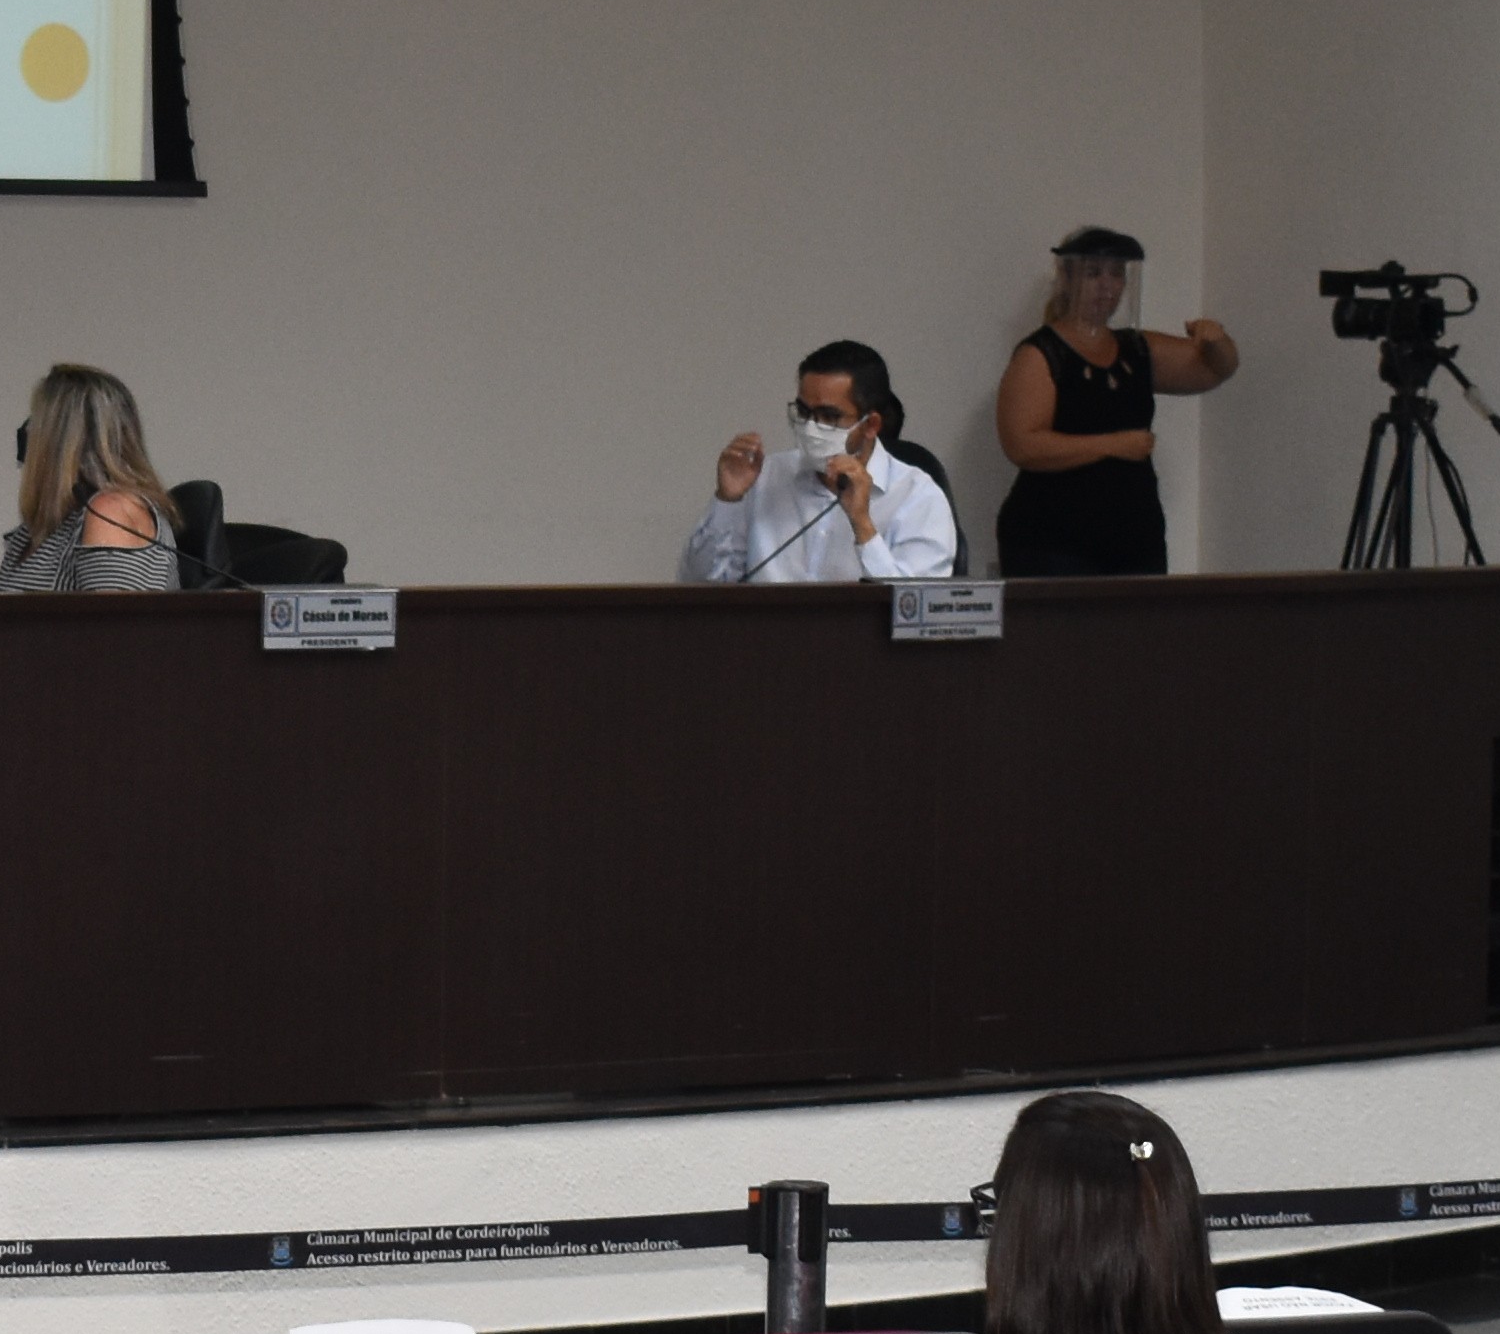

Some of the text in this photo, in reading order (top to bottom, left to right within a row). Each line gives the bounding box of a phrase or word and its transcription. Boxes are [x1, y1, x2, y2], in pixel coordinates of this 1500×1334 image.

[338, 611, 350, 621] de
[353, 610, 388, 621] Moraes
[1429, 1183, 1475, 1197] Câmara
[1430, 1203, 1470, 1216] Acesso
[1230, 1216, 1239, 1226] e
[1241, 1211, 1314, 1226] Vereadores.
[307, 1223, 550, 1245] Câmara Municipal de Cordeirópolis
[306, 1237, 682, 1266] Acesso restrito apenas para funcionários e Vereadores.
[75, 1263, 83, 1273] e
[87, 1259, 170, 1273] Vereadores.
